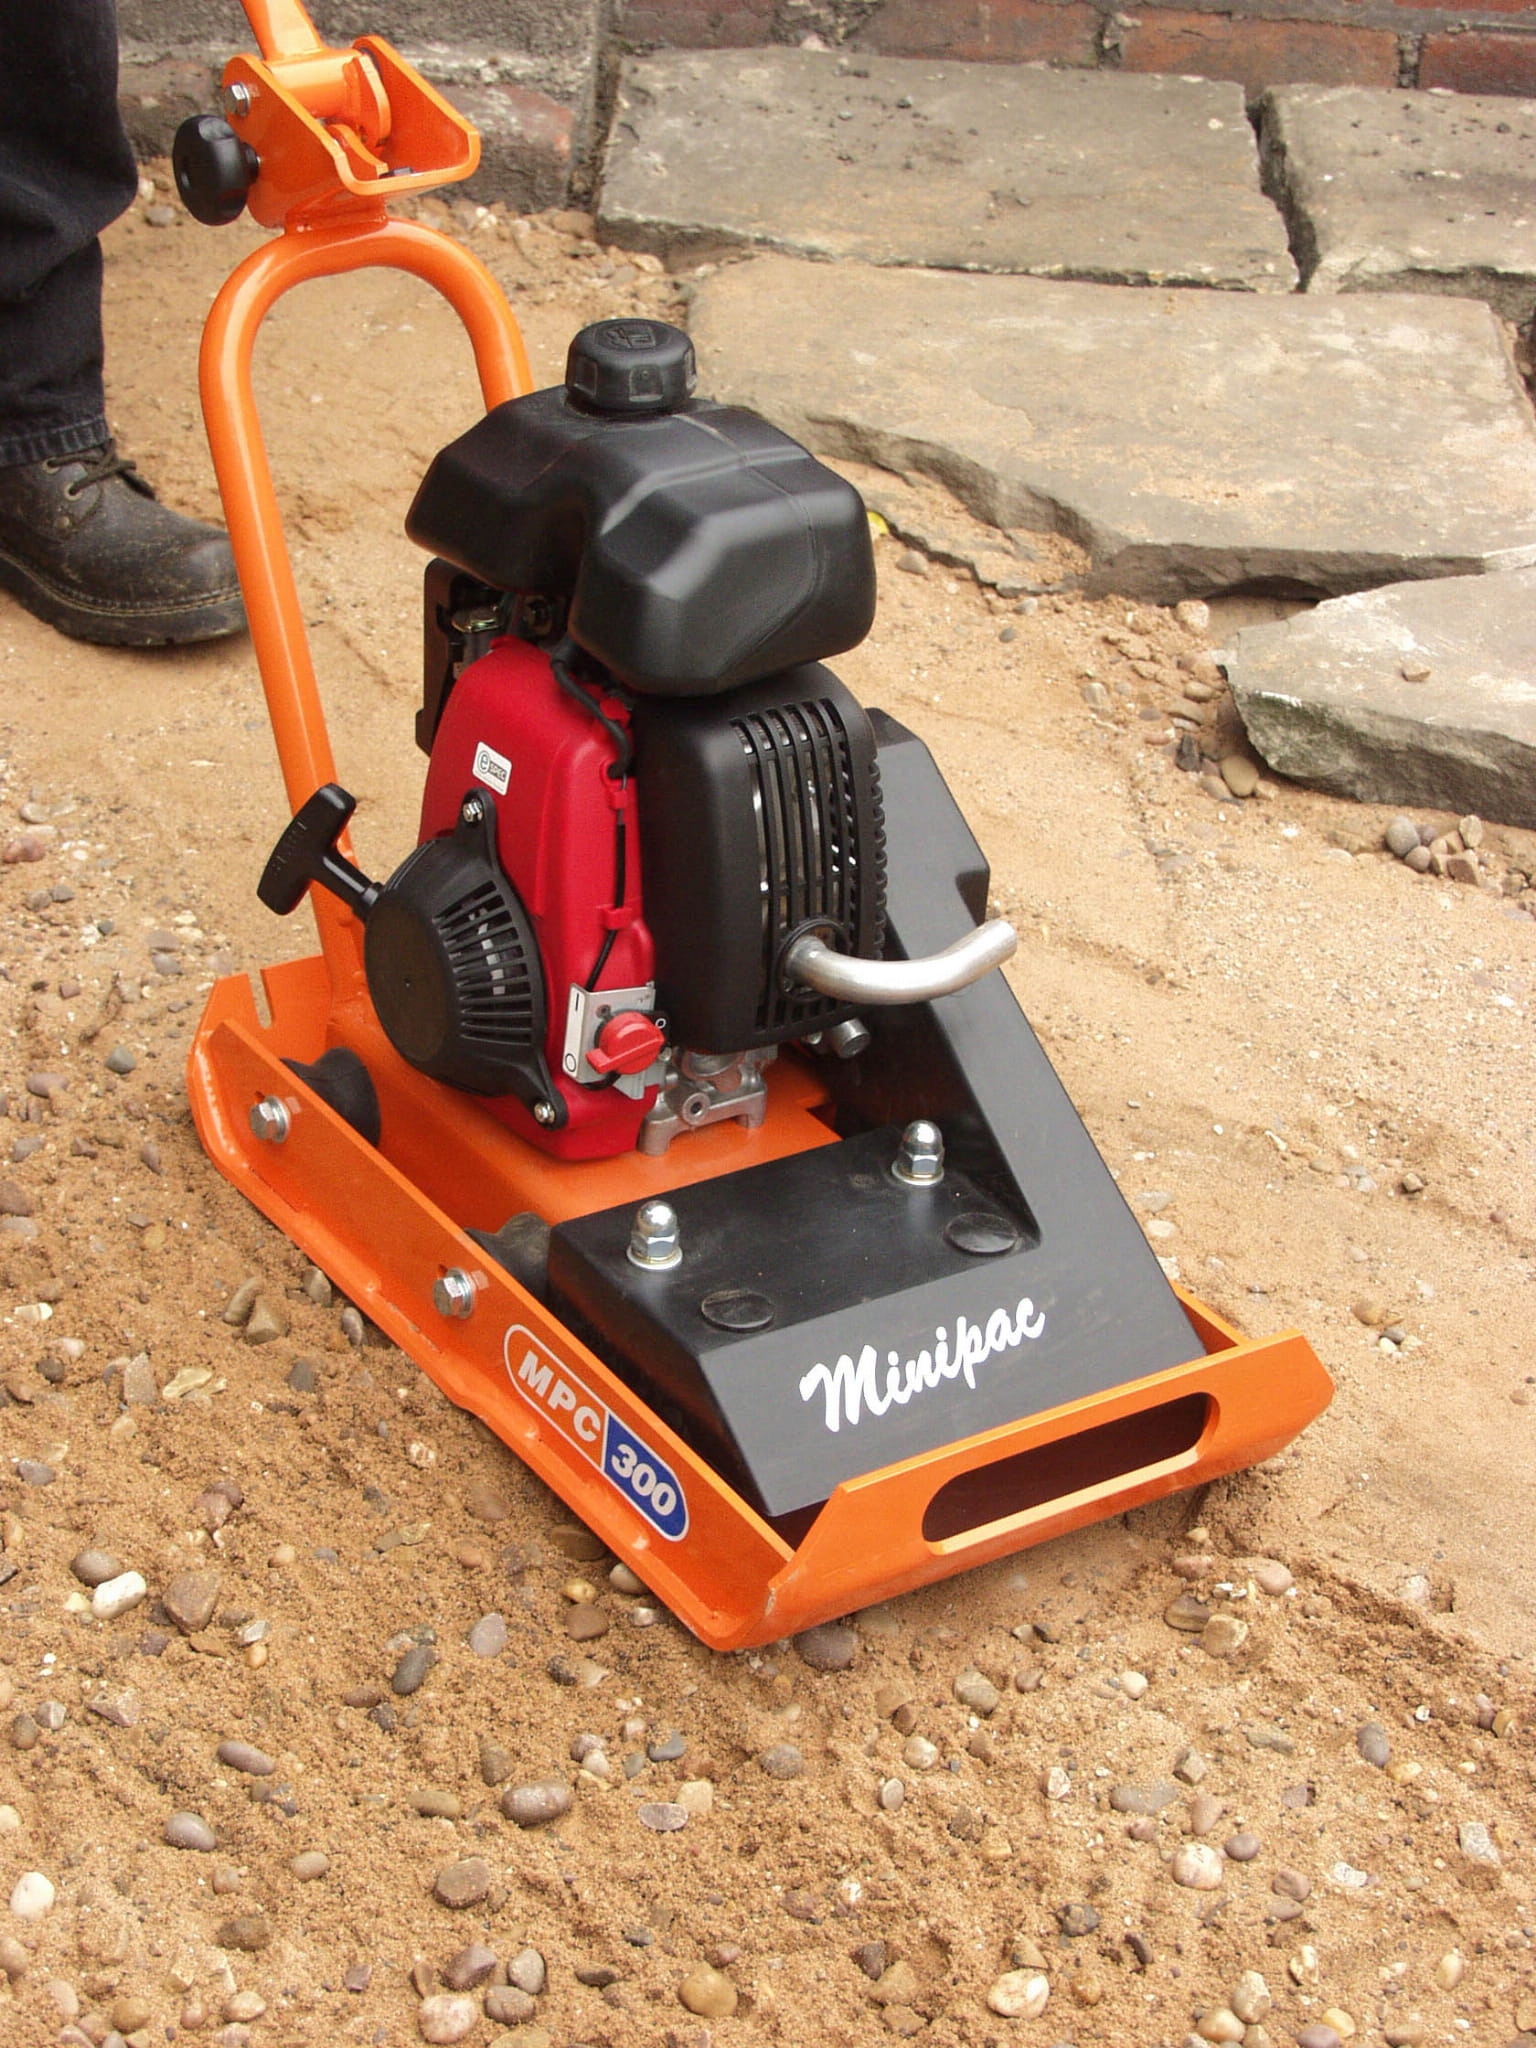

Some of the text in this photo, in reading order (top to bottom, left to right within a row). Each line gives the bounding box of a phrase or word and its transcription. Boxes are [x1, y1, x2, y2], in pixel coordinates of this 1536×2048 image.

[518, 1350, 677, 1516] MPC 300
[799, 1298, 1045, 1432] Minipac
